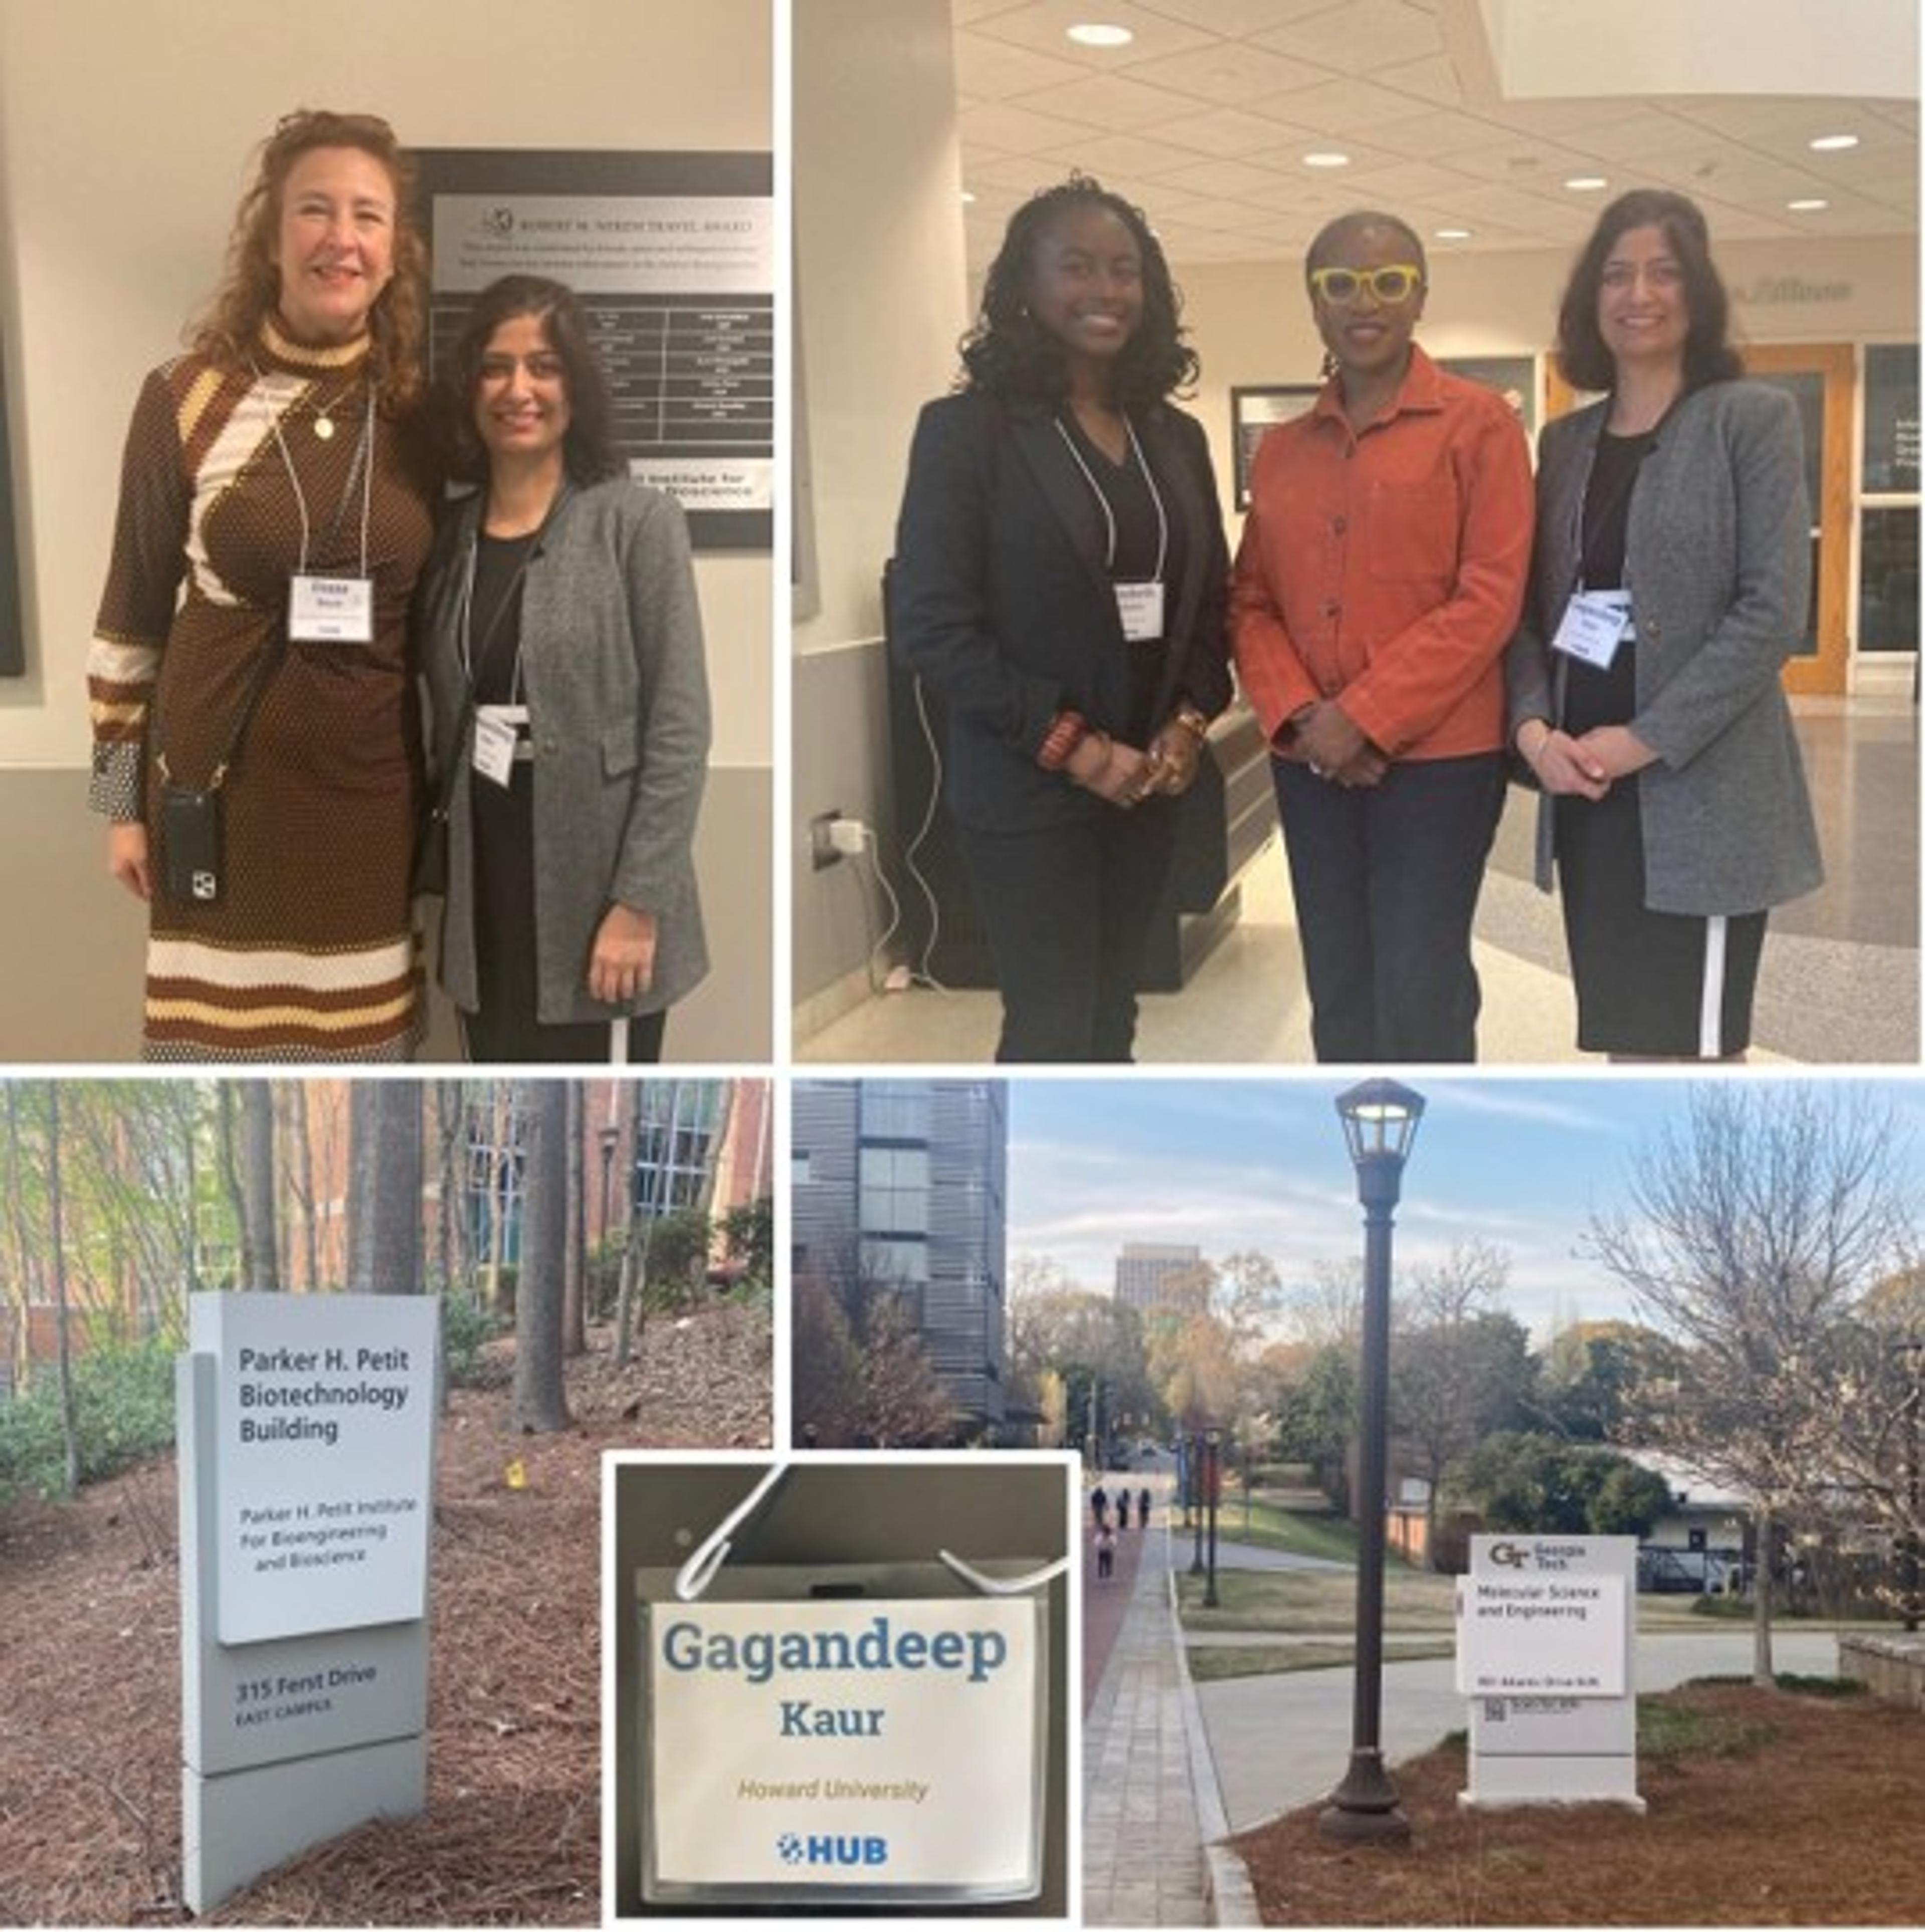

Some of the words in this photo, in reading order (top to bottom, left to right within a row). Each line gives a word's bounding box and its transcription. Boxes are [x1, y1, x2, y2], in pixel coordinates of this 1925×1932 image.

[239, 1348, 318, 1372] Parker
[325, 1348, 348, 1372] H.
[357, 1348, 409, 1372] Petit
[240, 1381, 409, 1410] Biotechnology
[240, 1417, 338, 1445] Building
[239, 1508, 291, 1523] Parker
[317, 1502, 351, 1517] Petit
[357, 1498, 417, 1514] Institute
[271, 1524, 387, 1547] Bioengineering
[255, 1553, 286, 1572] and
[289, 1549, 365, 1568] Bioscience
[1533, 1542, 1586, 1558] Georgia
[1534, 1558, 1568, 1570] Tech
[1477, 1586, 1544, 1600] Molecular
[1549, 1585, 1600, 1600] Science
[1477, 1605, 1503, 1618] and
[1506, 1604, 1587, 1621] Engineering
[663, 1618, 1007, 1684] Gagandeep
[236, 1680, 273, 1703] 315
[278, 1673, 323, 1695] Ferst
[328, 1664, 376, 1687] Drive
[235, 1708, 270, 1726] EAST
[780, 1701, 885, 1737] Kaur
[737, 1779, 820, 1801] Howard
[824, 1779, 930, 1805] University
[808, 1836, 888, 1865] HUB
